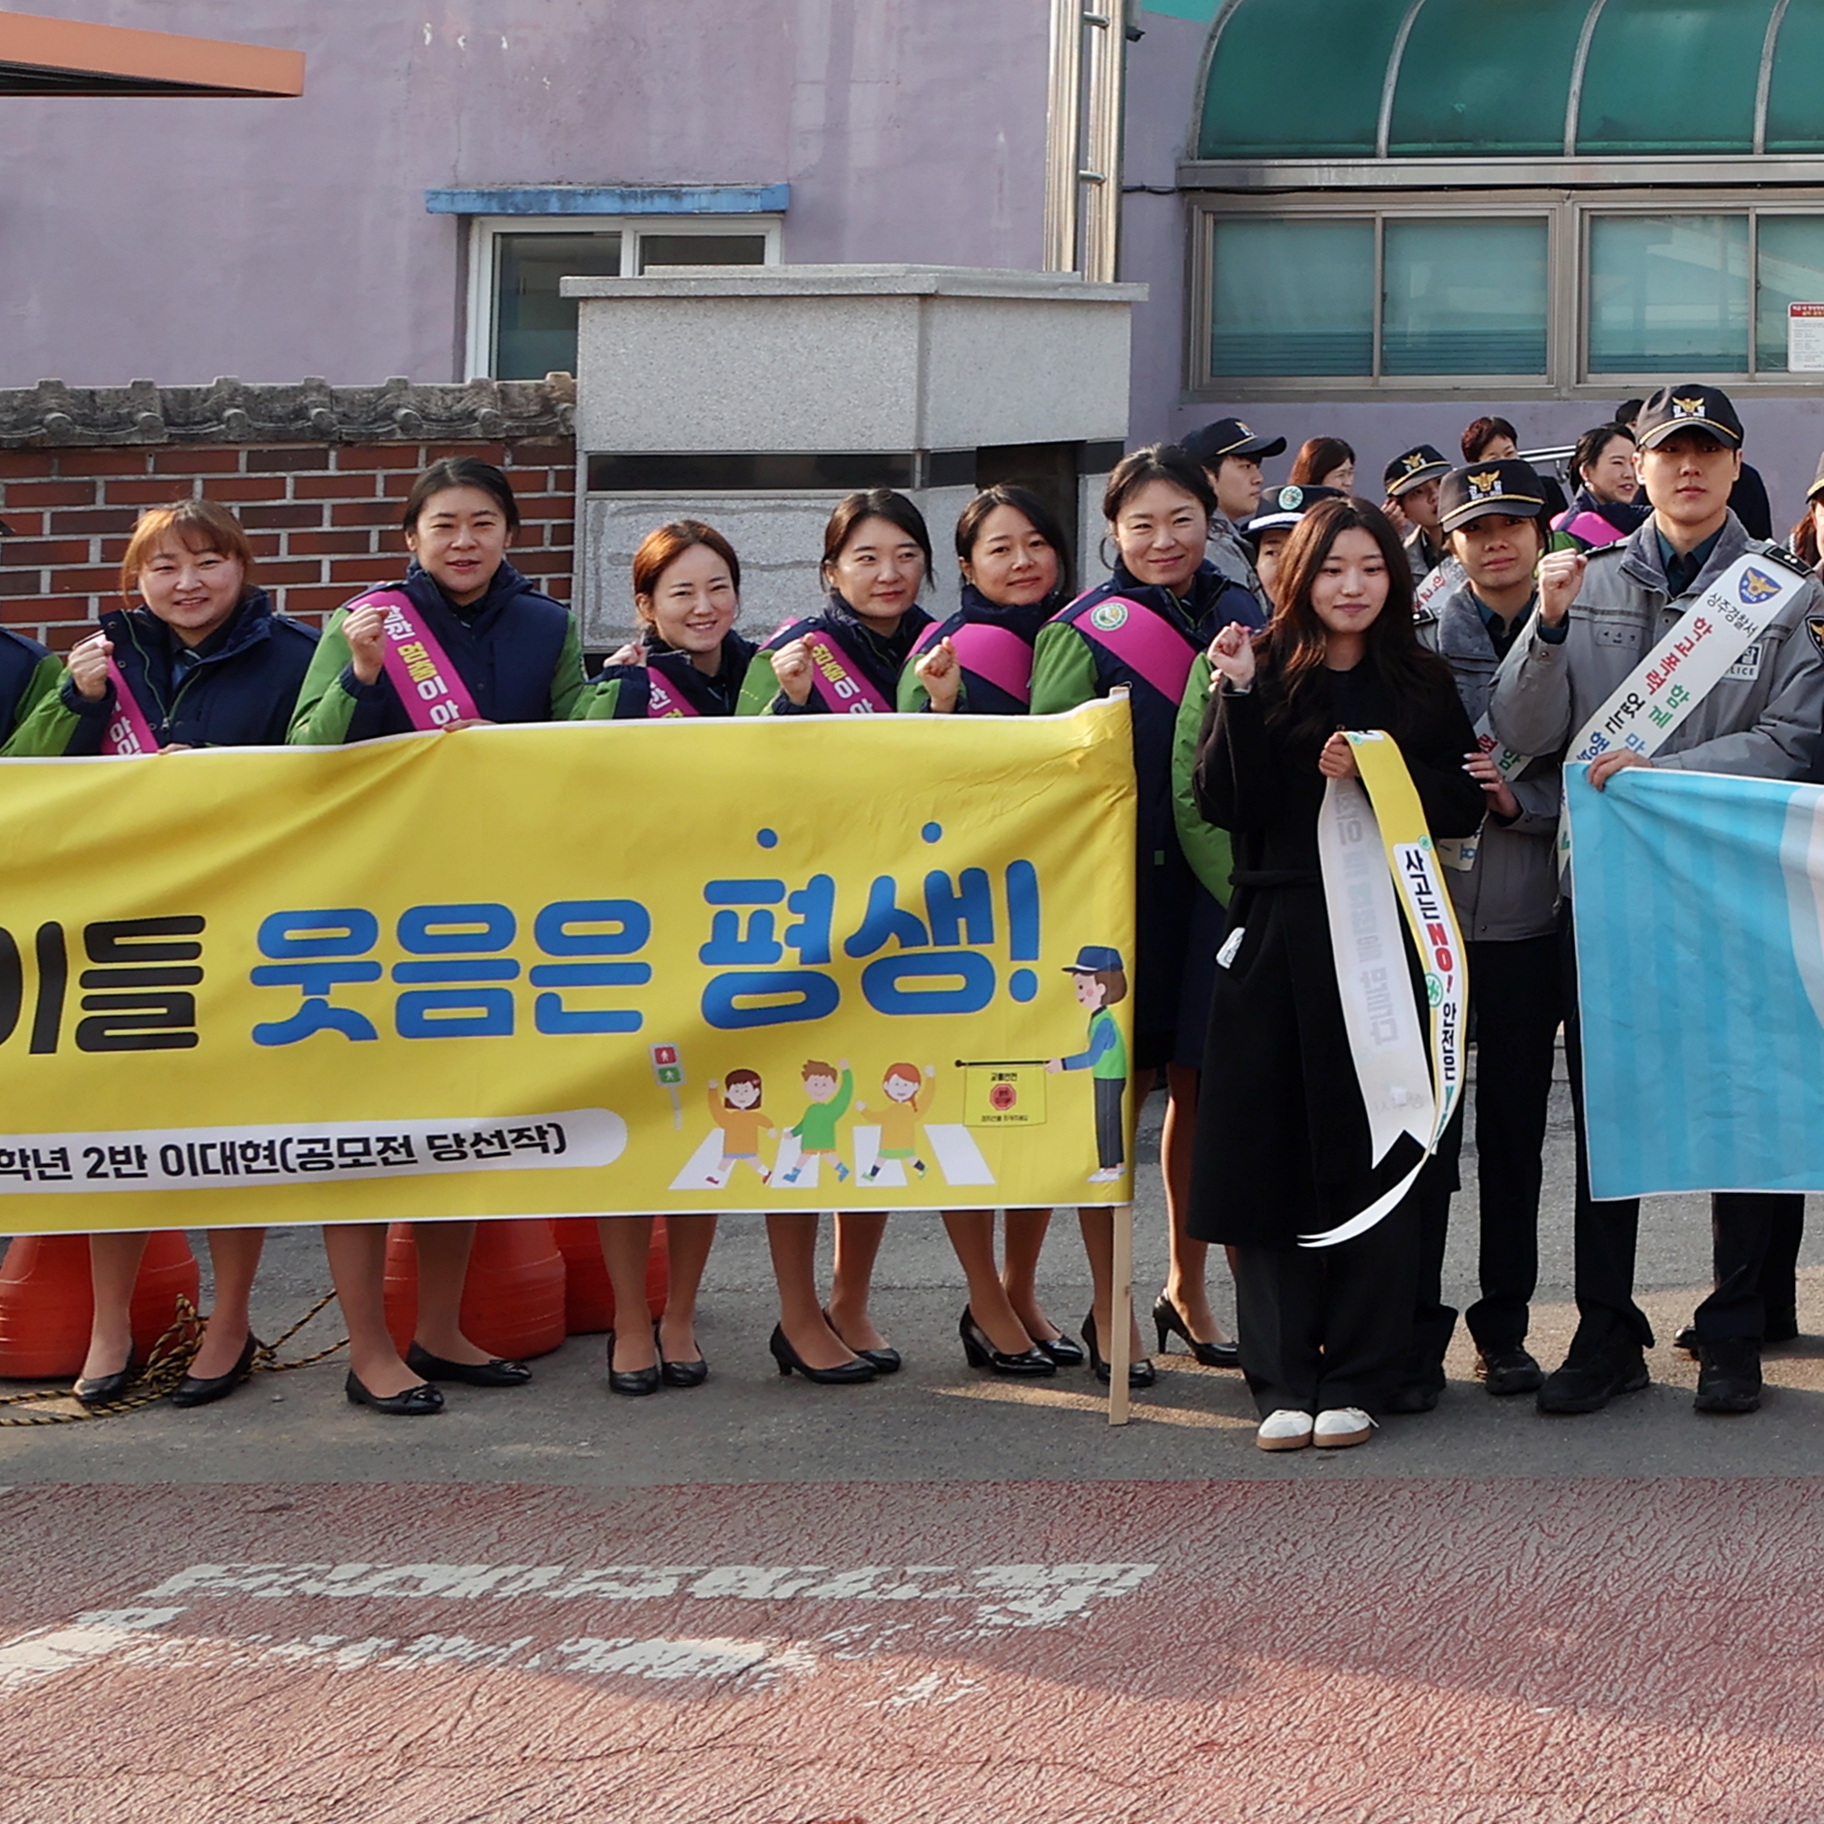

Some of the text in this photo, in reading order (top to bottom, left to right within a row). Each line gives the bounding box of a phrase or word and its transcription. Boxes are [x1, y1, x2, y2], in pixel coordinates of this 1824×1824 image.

[1706, 591, 1760, 639] 상주경찰서
[397, 643, 450, 702] 멈춤이
[1648, 616, 1713, 696] 학교폭력
[1605, 691, 1646, 735] 없는
[1648, 683, 1691, 729] 함께
[250, 898, 651, 1046] 웃음은
[699, 858, 1041, 1029] 평생!
[1403, 848, 1440, 922] 사고는
[1440, 1001, 1457, 1082] 안전은
[83, 1141, 148, 1179] 2반
[160, 1128, 416, 1181] 이대현(공모전
[426, 1121, 569, 1171] 당선작)
